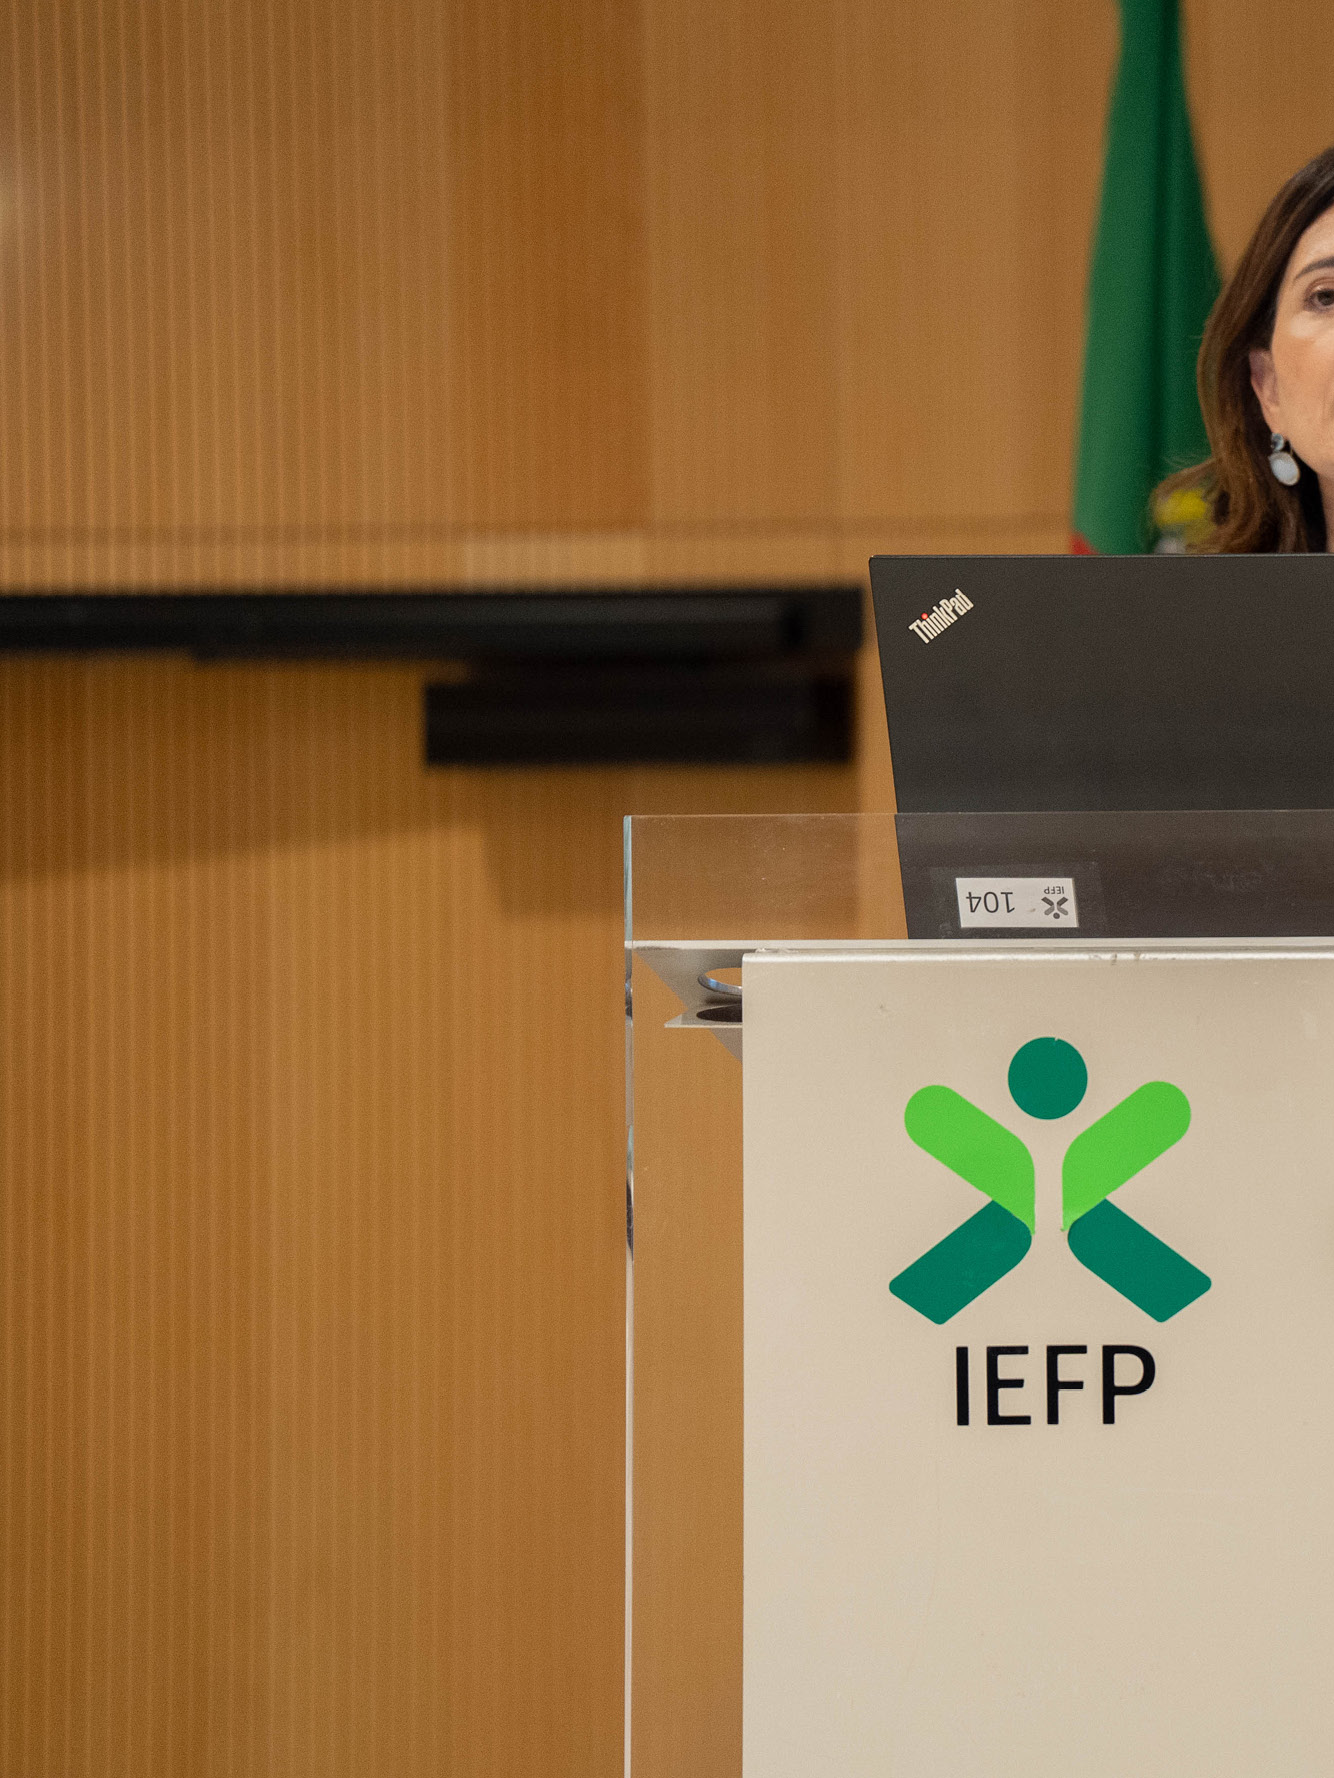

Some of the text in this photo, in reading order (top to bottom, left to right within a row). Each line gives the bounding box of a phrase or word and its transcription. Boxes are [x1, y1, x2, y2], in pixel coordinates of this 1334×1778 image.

[908, 588, 974, 644] ThinkPad
[965, 891, 1015, 914] 104
[1043, 886, 1065, 895] IEFP
[956, 1344, 1156, 1426] IEFP
